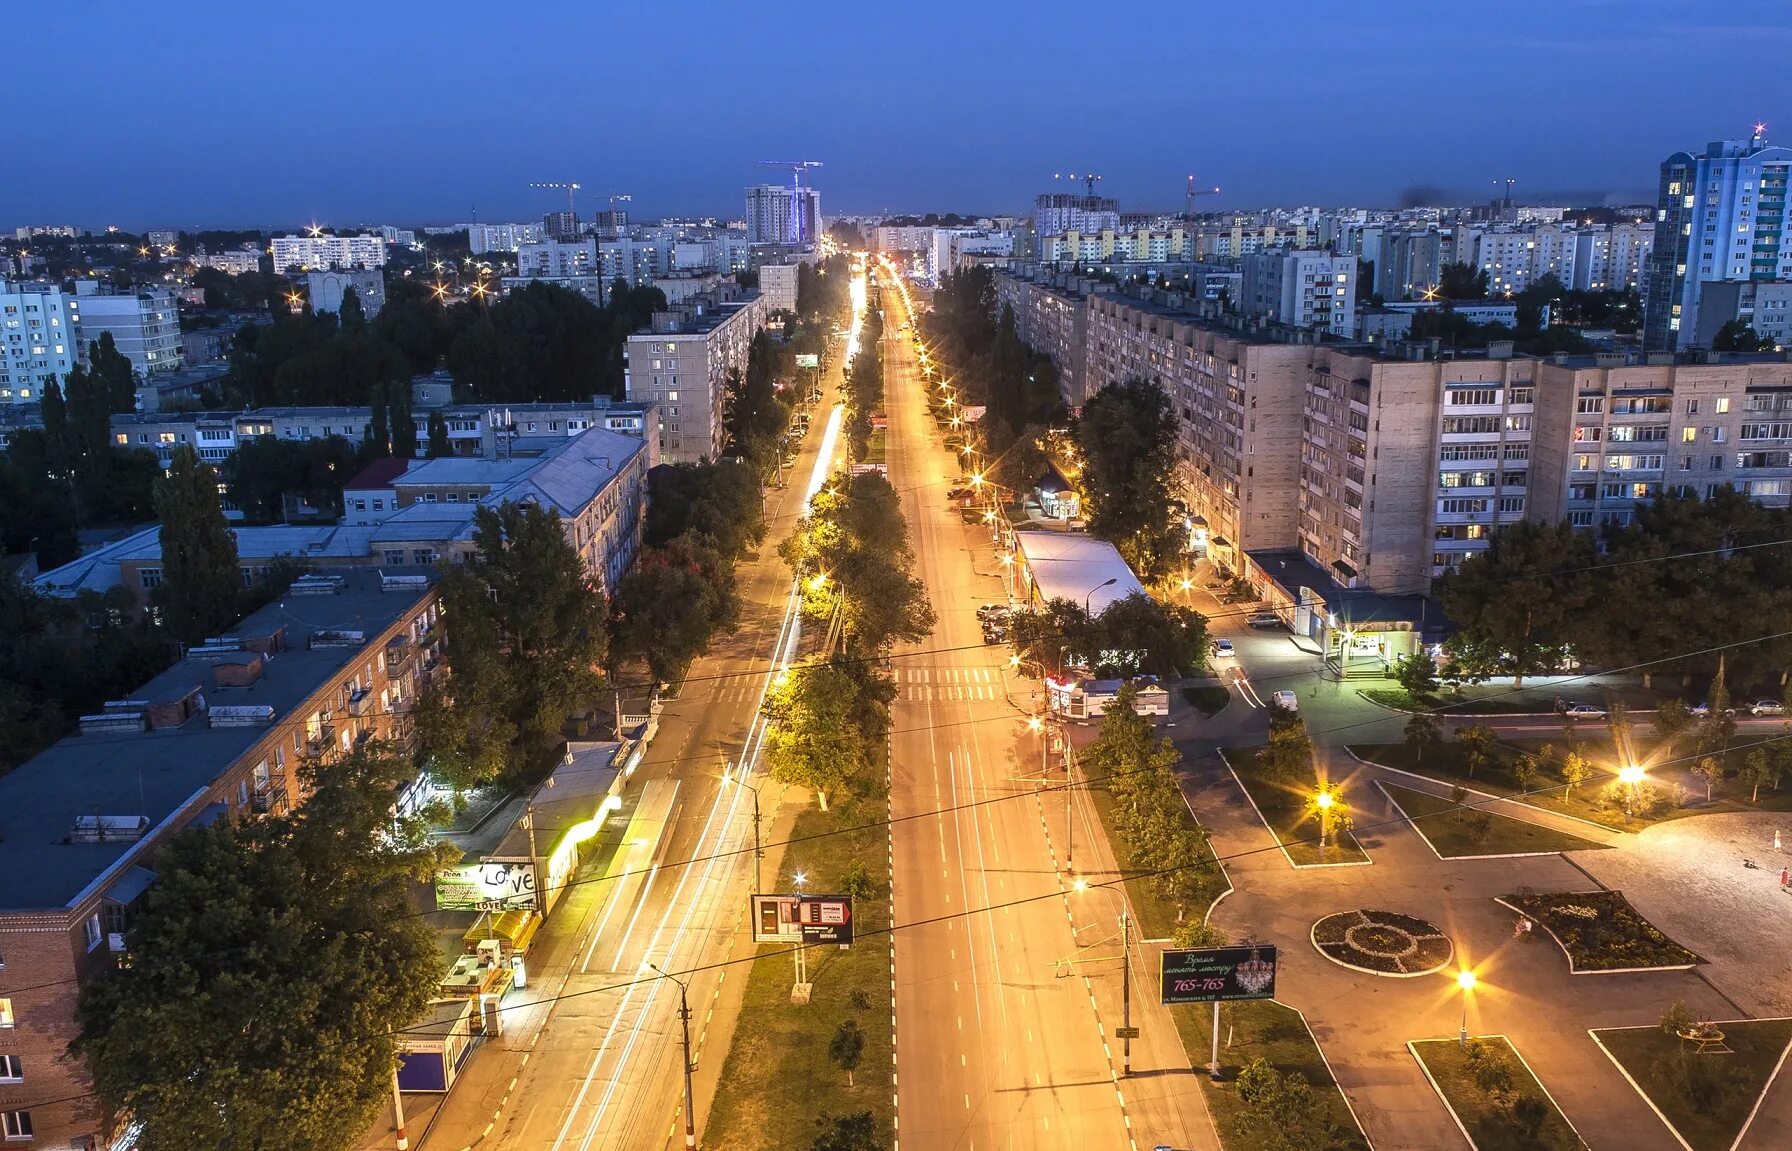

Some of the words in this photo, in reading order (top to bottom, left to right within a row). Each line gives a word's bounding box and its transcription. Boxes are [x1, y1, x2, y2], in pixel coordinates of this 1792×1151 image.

[476, 902, 501, 911] LOVE
[1184, 953, 1215, 967] Время
[1164, 966, 1196, 975] менять
[1174, 978, 1226, 993] 765-765
